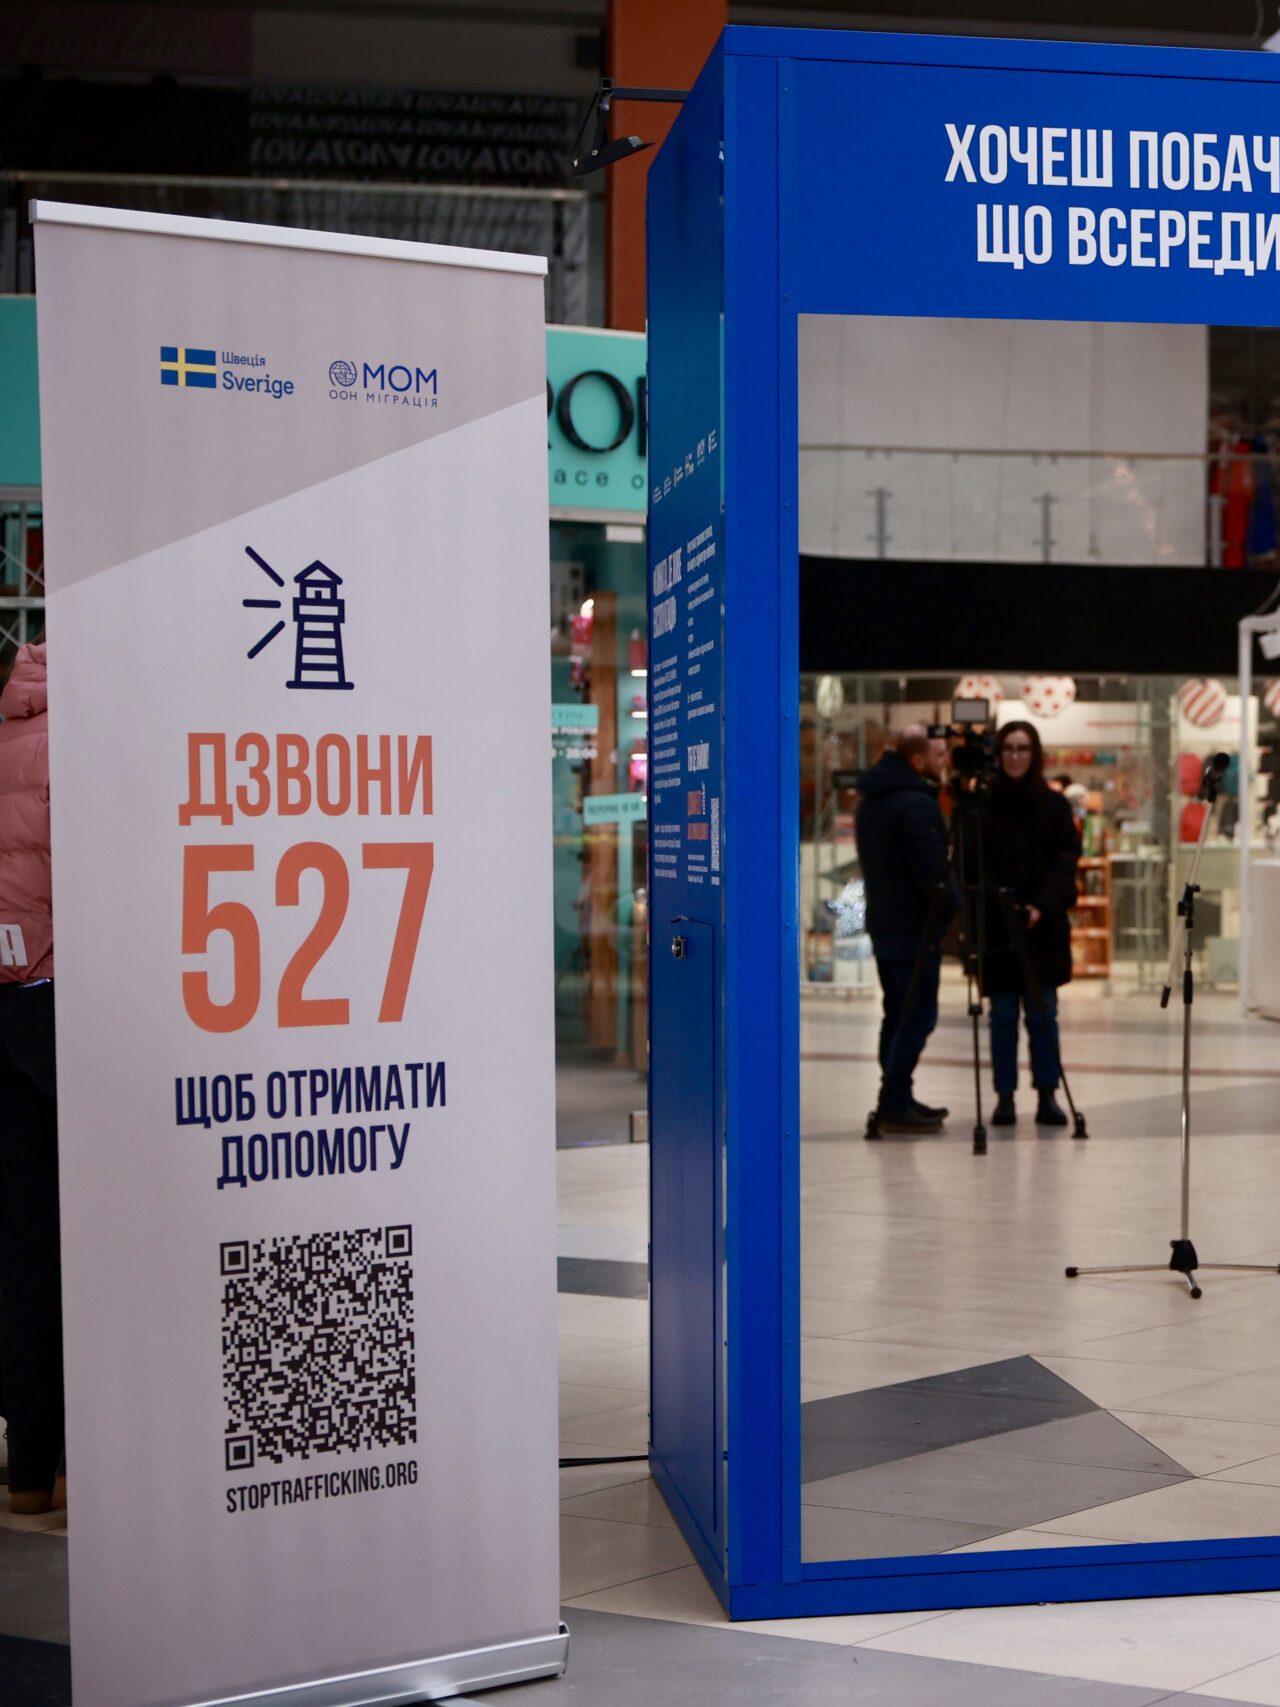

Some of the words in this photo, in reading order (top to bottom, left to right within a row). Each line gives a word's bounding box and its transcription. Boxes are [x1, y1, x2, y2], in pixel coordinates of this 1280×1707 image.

[944, 123, 1113, 188] ХОЧЕШ
[976, 203, 1053, 270] ЩО
[222, 351, 266, 368] Швеція
[222, 370, 295, 399] Sverige
[363, 362, 438, 395] МОМ
[328, 390, 357, 401] ООН
[366, 392, 438, 408] МІГРАЦІЯ
[179, 732, 433, 826] ДЗВОНИ
[182, 841, 434, 1033] 527
[175, 1073, 256, 1129] ЩОБ
[267, 1061, 446, 1119] ОТРИМАТИ
[217, 1122, 411, 1190] ДОПОМОГУ
[226, 1460, 418, 1513] STOPTRAFFICKING.ORG
